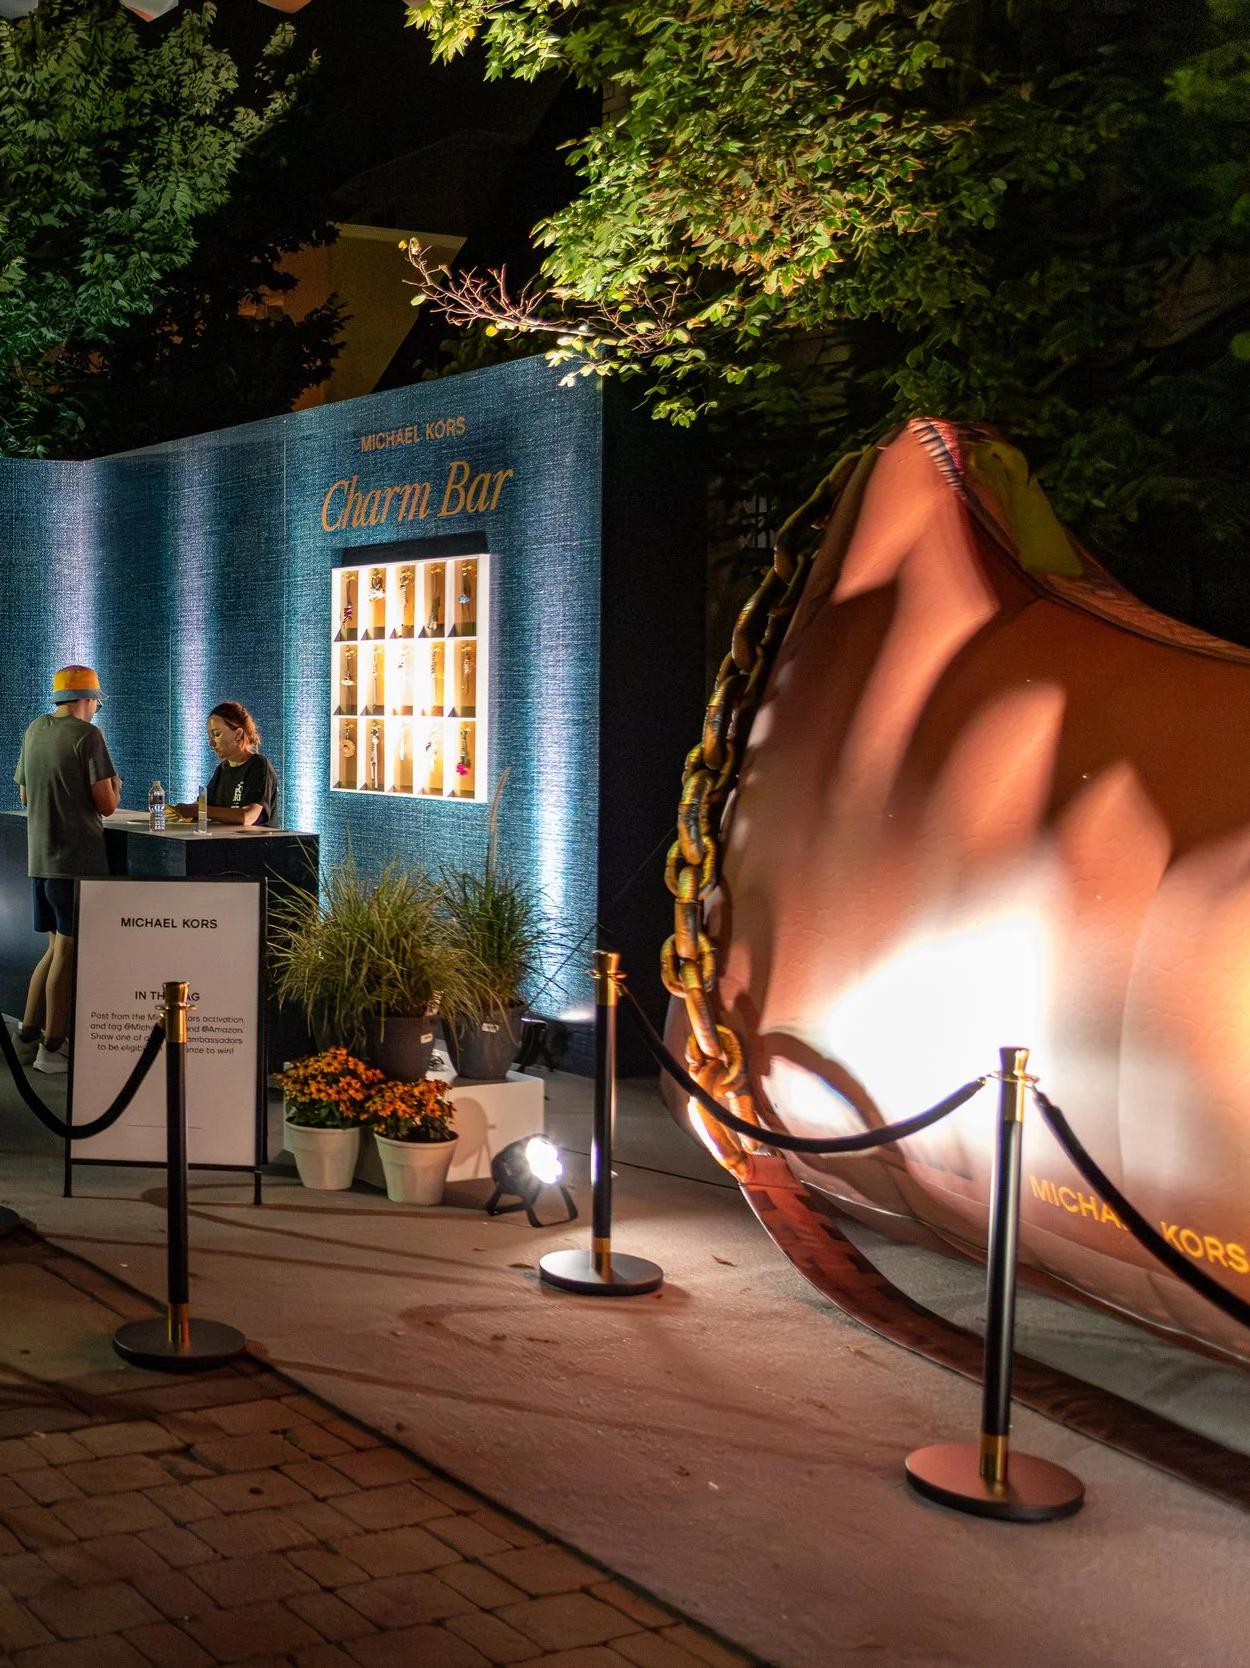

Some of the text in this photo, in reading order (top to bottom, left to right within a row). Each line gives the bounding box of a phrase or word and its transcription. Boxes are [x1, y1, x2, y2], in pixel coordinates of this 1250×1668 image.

[360, 416, 467, 453] MICHAEL KORS
[321, 460, 514, 532] Charm Bar
[120, 917, 218, 930] MICHAEL KORS
[135, 991, 147, 1001] IN
[149, 991, 165, 1001] TH
[91, 1011, 109, 1020] Post
[111, 1012, 130, 1021] from
[132, 1012, 146, 1021] the
[202, 1015, 244, 1024] activation
[108, 1023, 123, 1032] tag
[90, 1032, 114, 1041] Show
[133, 1033, 143, 1041] of
[1028, 1174, 1250, 1275] MICHA KORS
